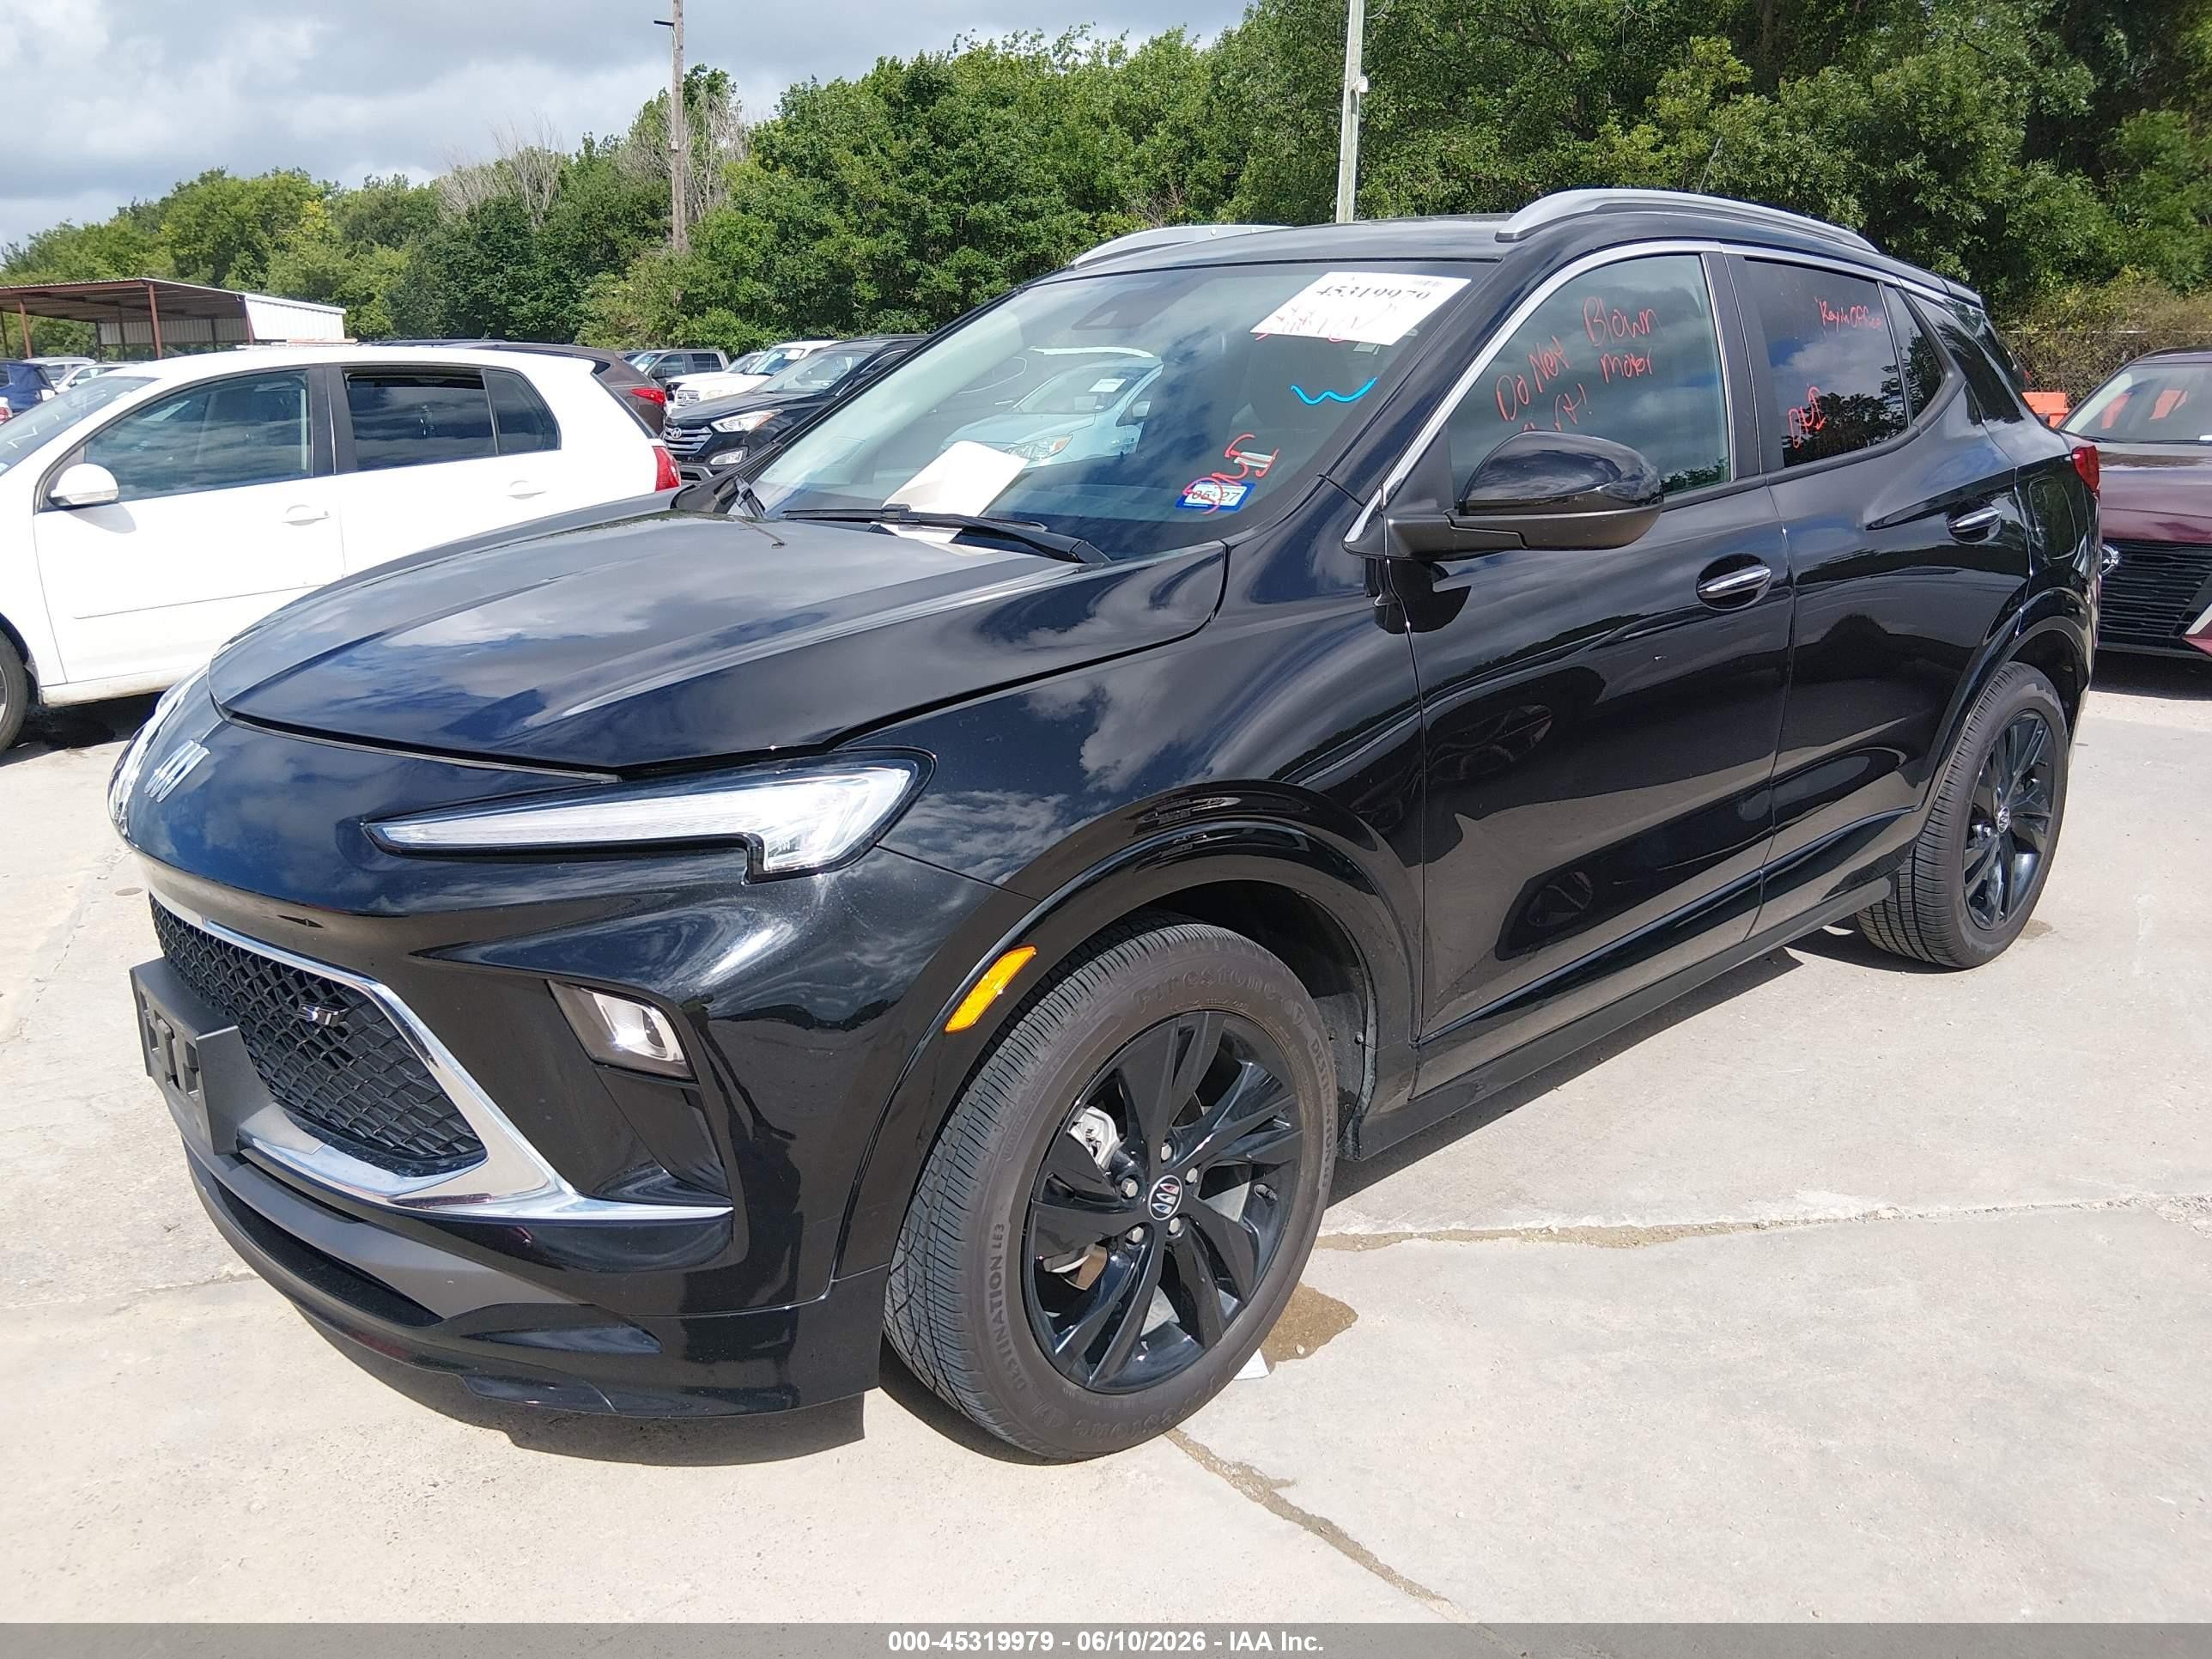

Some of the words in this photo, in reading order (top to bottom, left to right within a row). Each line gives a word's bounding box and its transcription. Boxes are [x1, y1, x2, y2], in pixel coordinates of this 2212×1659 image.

[1583, 296, 1664, 347] Blown
[1496, 374, 1530, 421] Do
[1528, 335, 1570, 393] Not
[993, 1222, 1005, 1249] LE3
[989, 1255, 1027, 1390] DESTINATION
